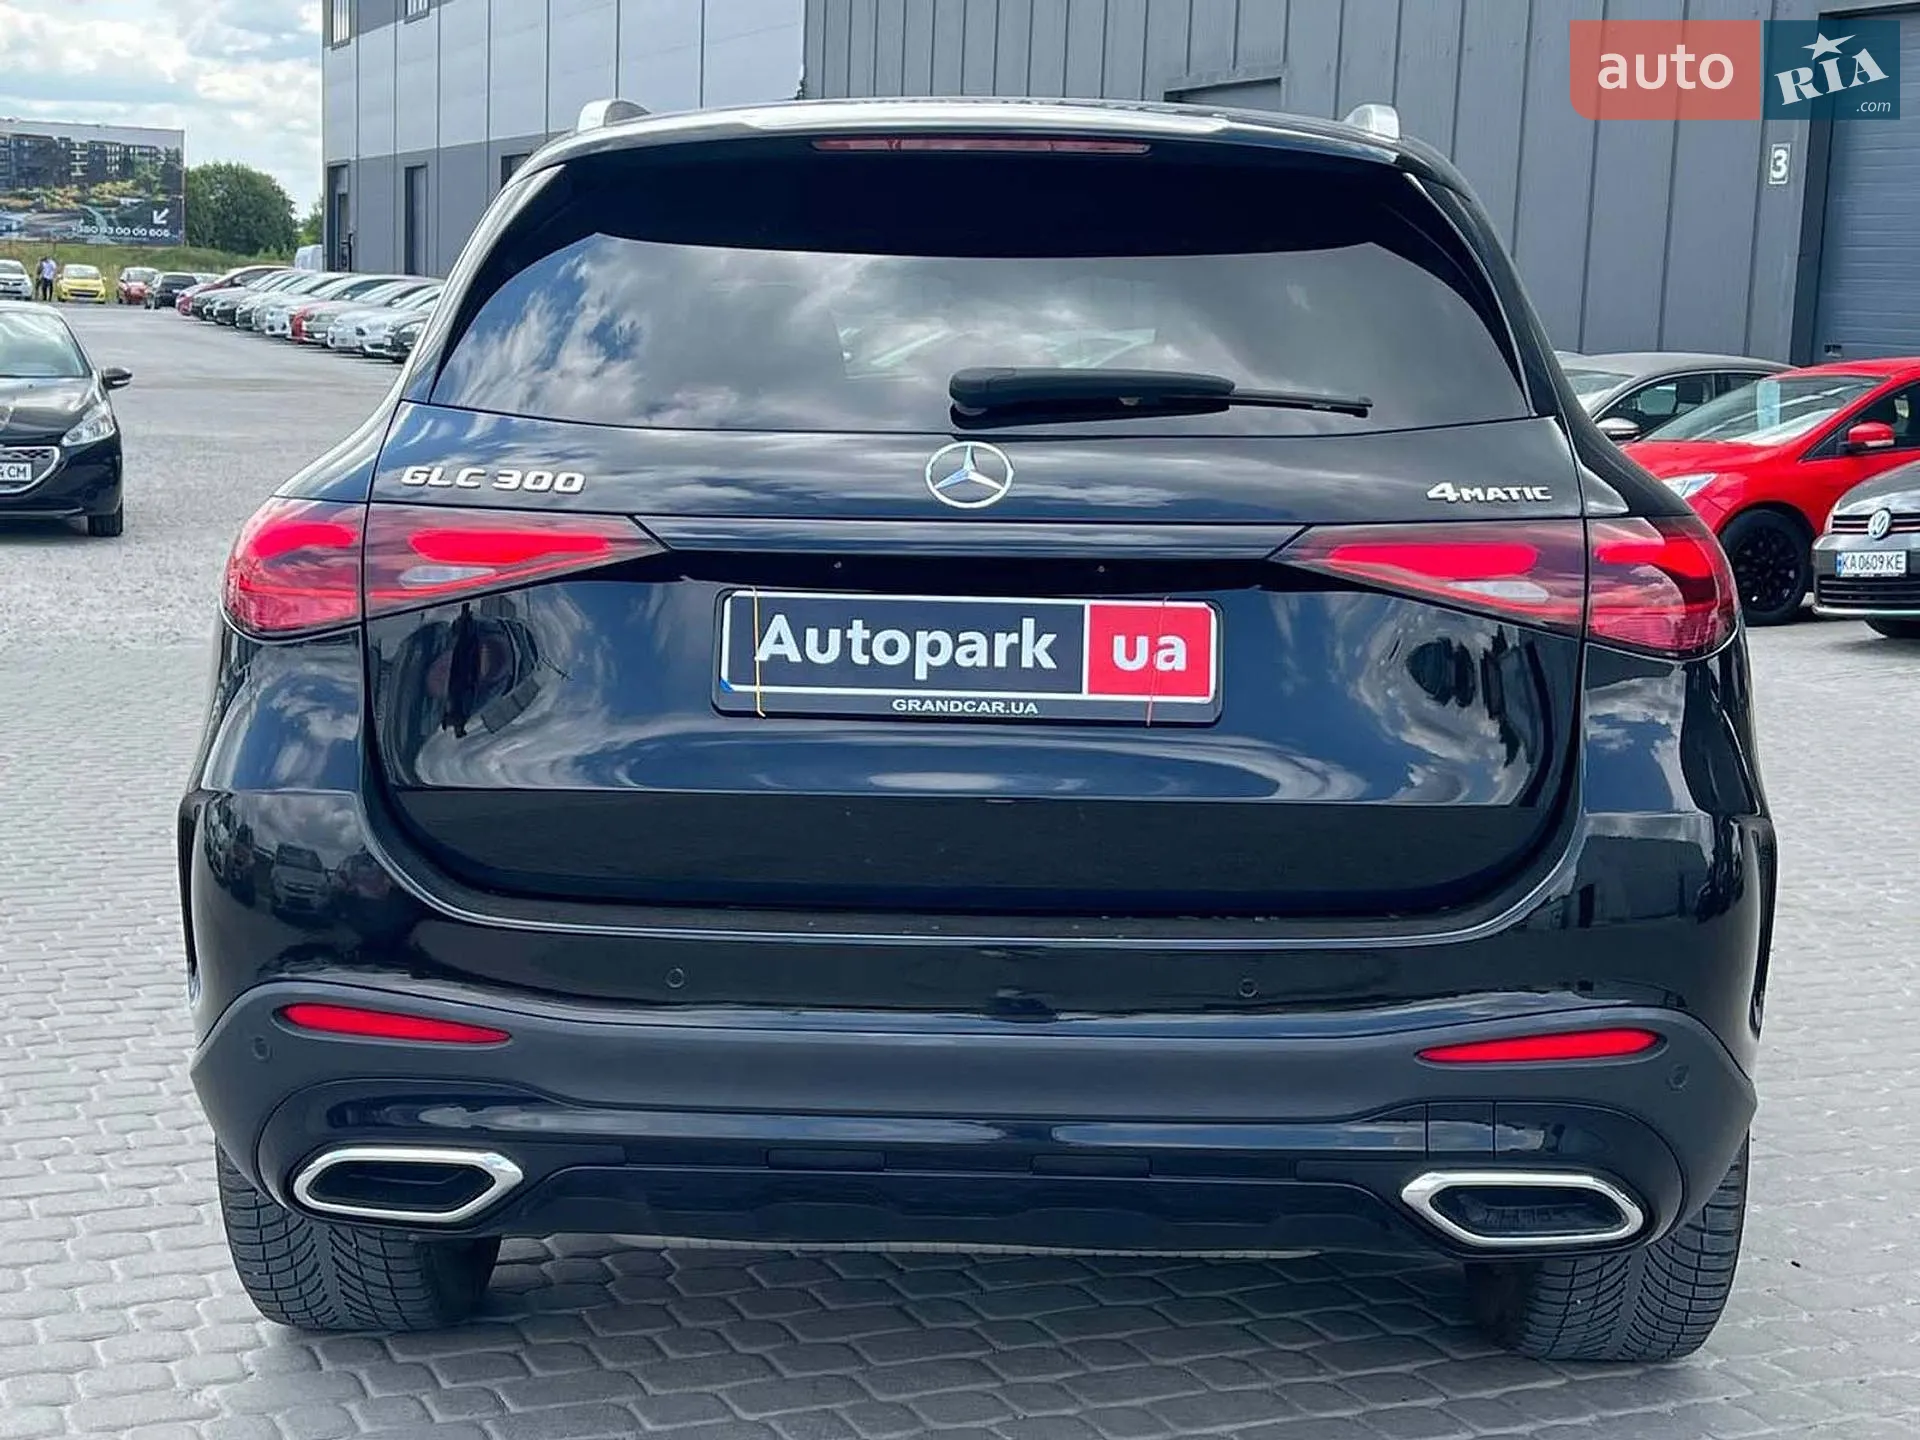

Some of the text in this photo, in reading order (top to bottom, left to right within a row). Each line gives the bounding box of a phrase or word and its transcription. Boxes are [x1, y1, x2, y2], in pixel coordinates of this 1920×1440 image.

[1771, 148, 1789, 179] 3
[401, 466, 586, 494] GLC 300
[1426, 481, 1552, 502] 4MATIC
[756, 613, 1187, 681] Autopark ua
[891, 698, 1039, 715] GRANDCAR.UA
